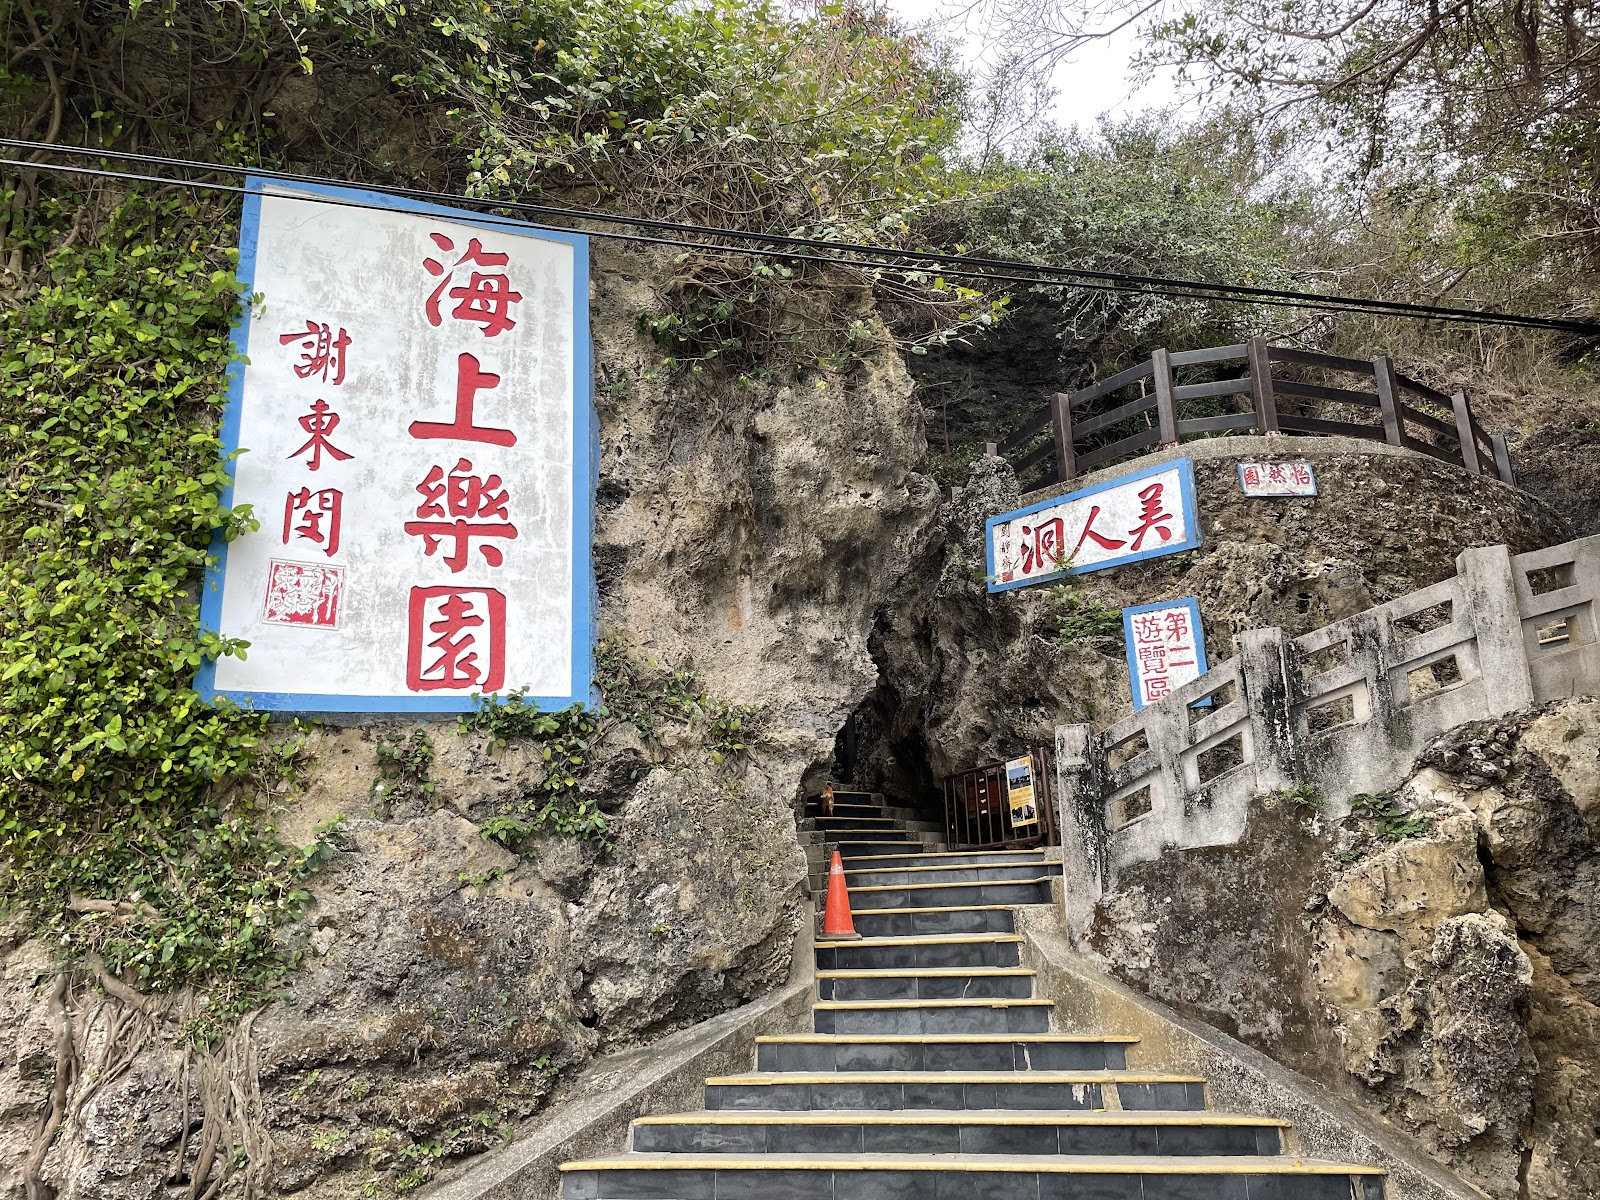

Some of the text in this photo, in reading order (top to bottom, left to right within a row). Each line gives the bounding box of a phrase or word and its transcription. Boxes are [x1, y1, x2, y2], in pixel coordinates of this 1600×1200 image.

[279, 319, 355, 557] 謝東閔
[404, 232, 523, 694] 海上樂園
[1243, 465, 1311, 486] 怡然園
[1020, 483, 1173, 574] 美人洞
[1134, 615, 1171, 702] 遊覽區
[1164, 612, 1195, 668] 第二
